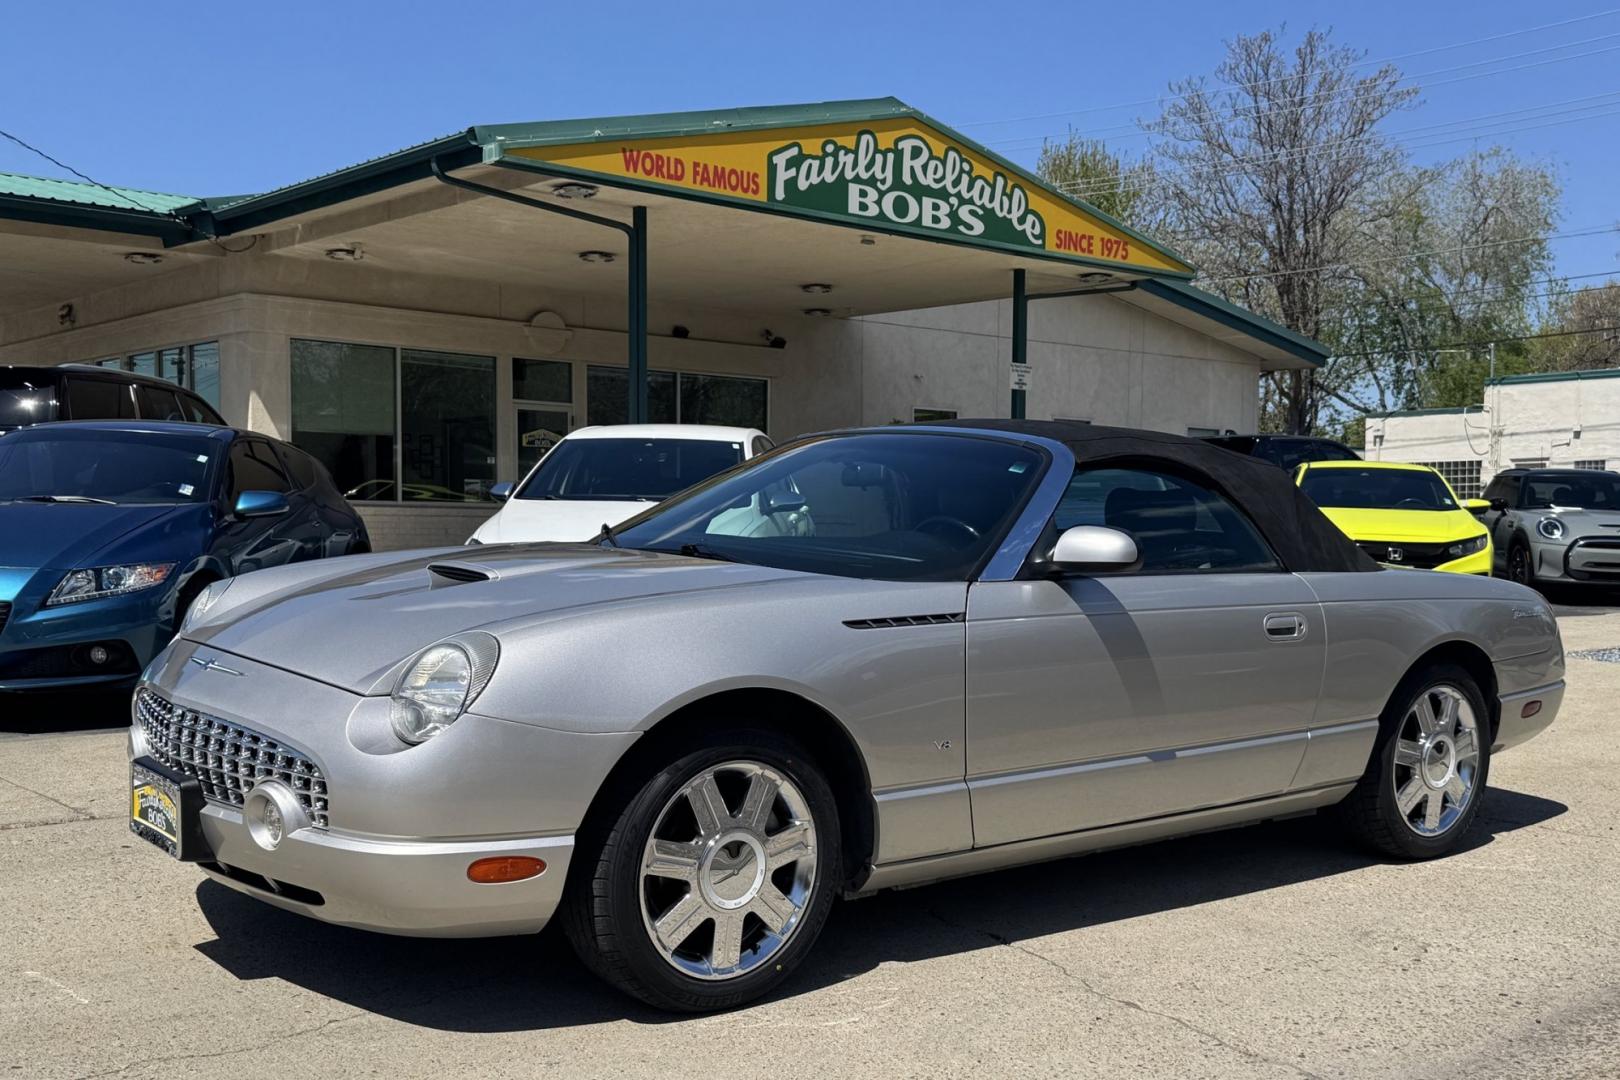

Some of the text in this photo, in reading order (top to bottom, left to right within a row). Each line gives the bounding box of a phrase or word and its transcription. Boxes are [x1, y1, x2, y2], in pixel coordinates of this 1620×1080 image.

[621, 147, 760, 196] WORLD FAMOUS
[772, 133, 1043, 245] Fairly Reliable
[848, 181, 985, 237] BOB'S
[1055, 228, 1129, 260] SINCE 1975
